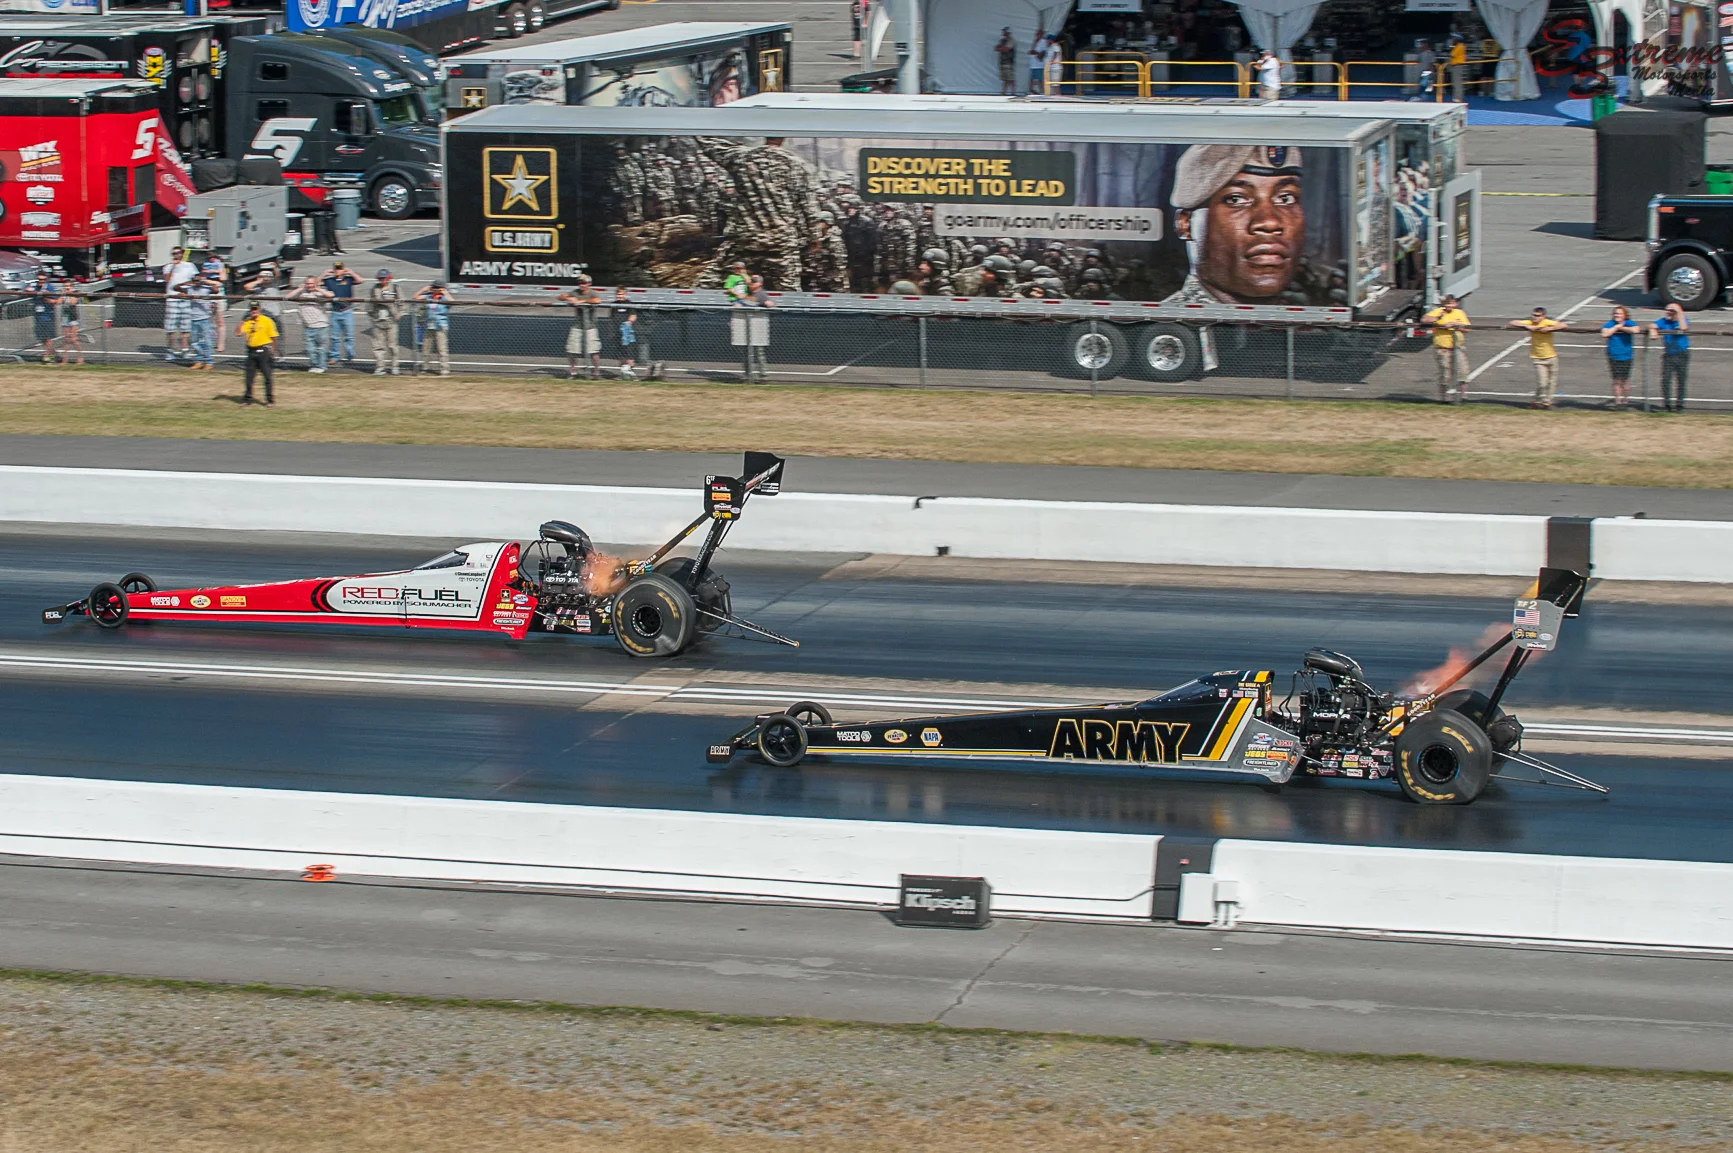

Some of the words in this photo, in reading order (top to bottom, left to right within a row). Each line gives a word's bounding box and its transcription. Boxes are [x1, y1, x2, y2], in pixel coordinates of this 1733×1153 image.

[131, 117, 159, 160] 5
[243, 117, 318, 167] 5
[867, 157, 967, 176] DISCOVER
[970, 158, 1012, 177] THE
[867, 176, 975, 196] STRENGTH
[977, 178, 1008, 197] TO
[1009, 179, 1065, 198] LEAD
[944, 212, 1153, 235] goarmy.com/officership
[459, 260, 511, 276] ARMY
[705, 475, 711, 485] 6
[342, 586, 399, 600] RED
[401, 587, 472, 602] FUEL
[406, 601, 472, 609] SCHUMACHER
[1528, 600, 1538, 609] 2
[1406, 693, 1436, 717] GOODYEAR
[924, 732, 940, 742] NAPA
[1049, 718, 1191, 765] ARMY
[709, 745, 730, 755] ARMY
